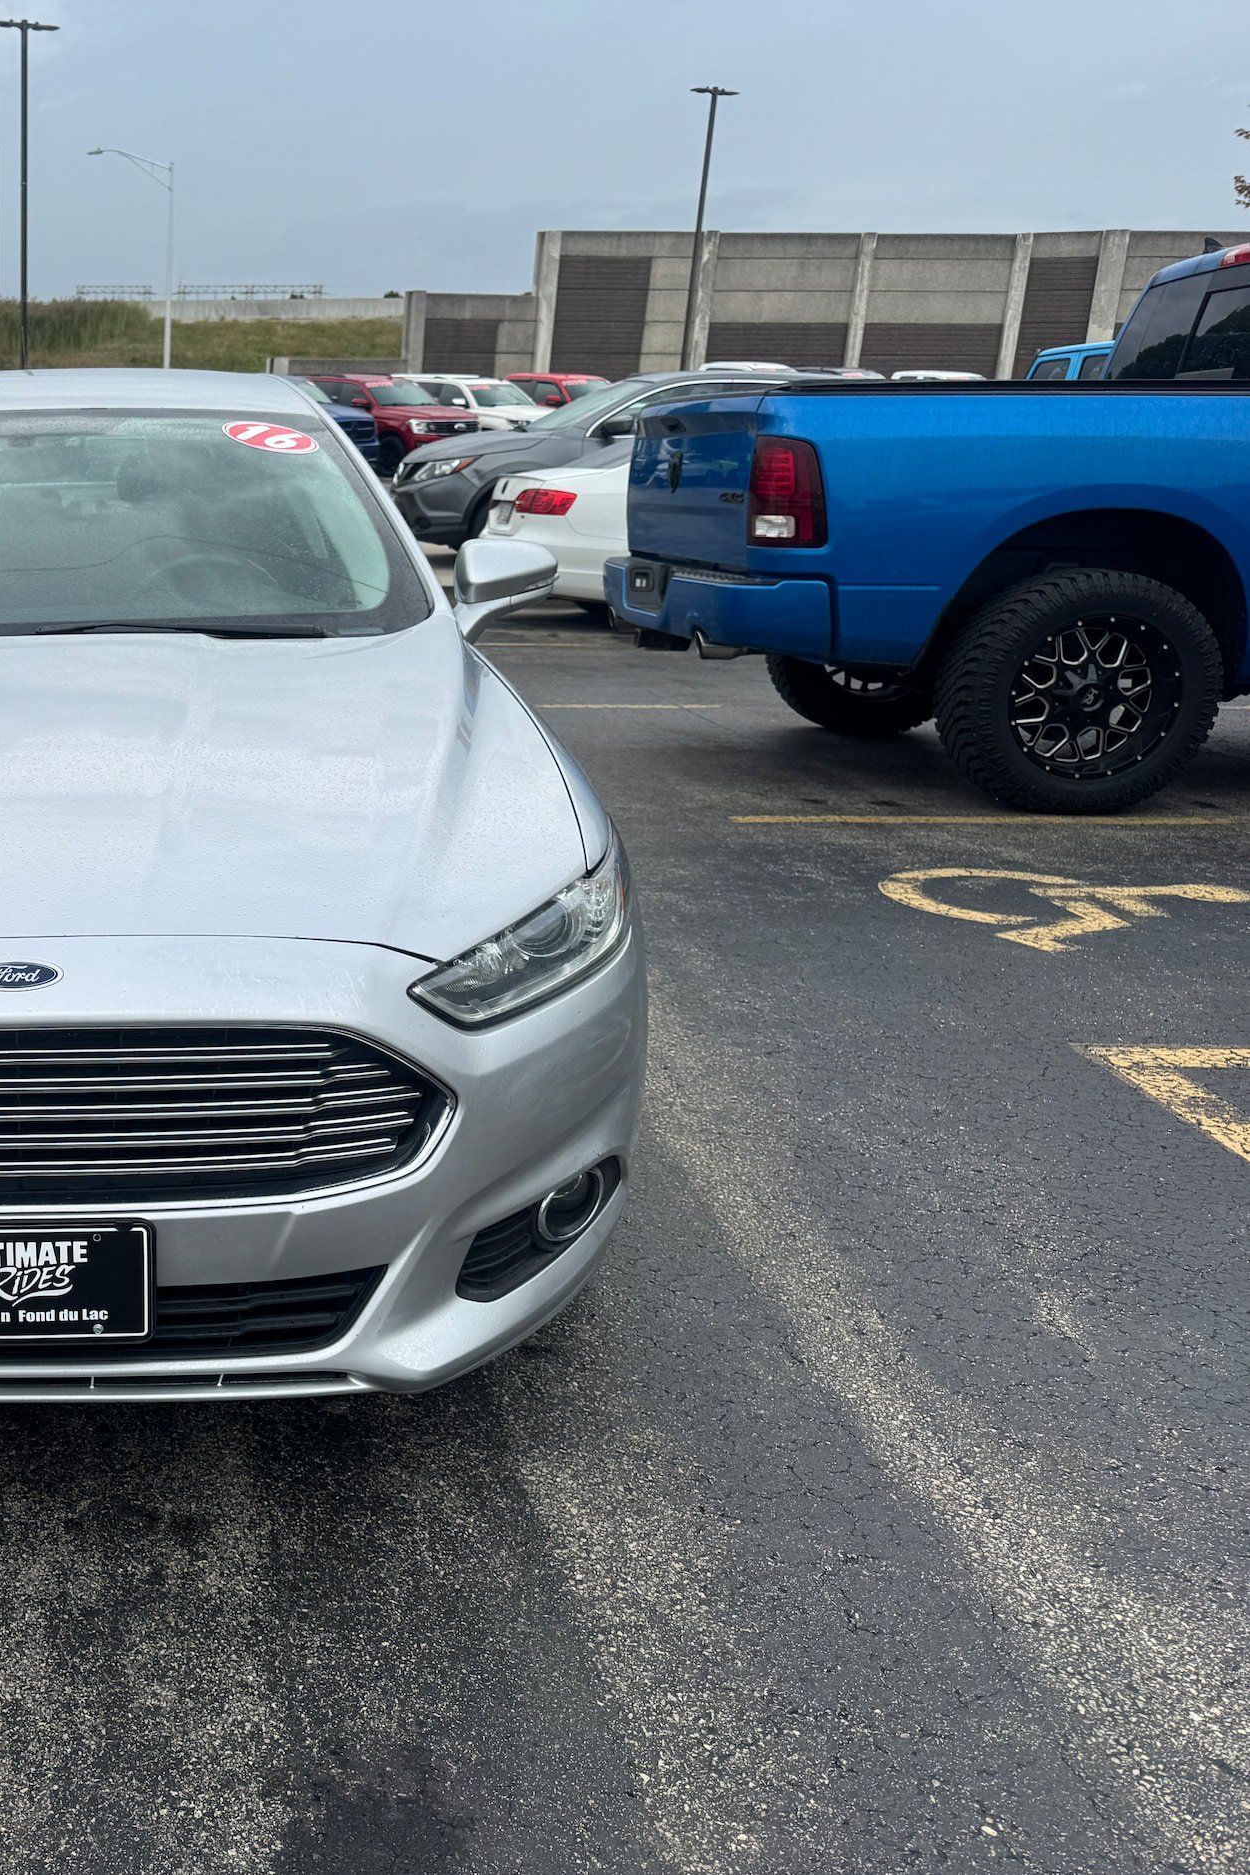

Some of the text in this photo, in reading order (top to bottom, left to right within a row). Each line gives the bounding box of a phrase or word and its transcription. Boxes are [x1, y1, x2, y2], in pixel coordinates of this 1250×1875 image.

[236, 425, 303, 449] 16
[18, 1309, 56, 1322] Fond
[58, 1308, 79, 1321] du
[82, 1308, 109, 1321] Lac
